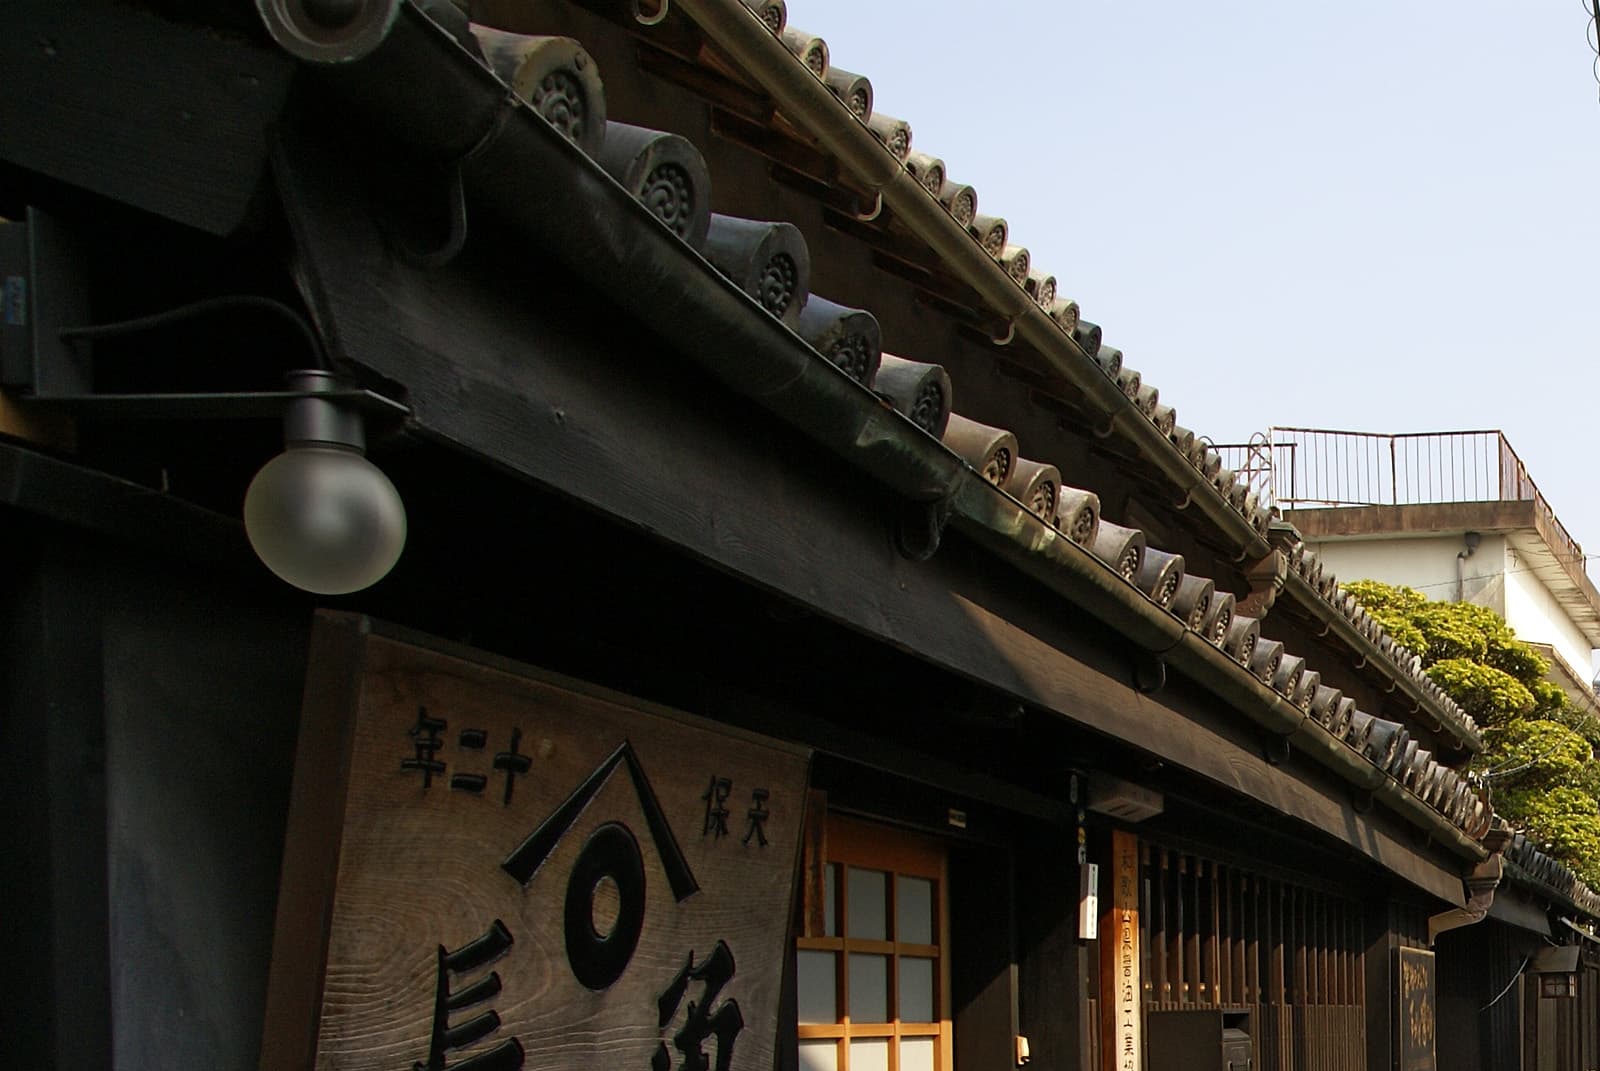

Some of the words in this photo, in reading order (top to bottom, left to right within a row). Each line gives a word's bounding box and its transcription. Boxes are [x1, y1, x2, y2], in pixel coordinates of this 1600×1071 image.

[401, 706, 532, 805] 十二年
[702, 775, 769, 847] 天保
